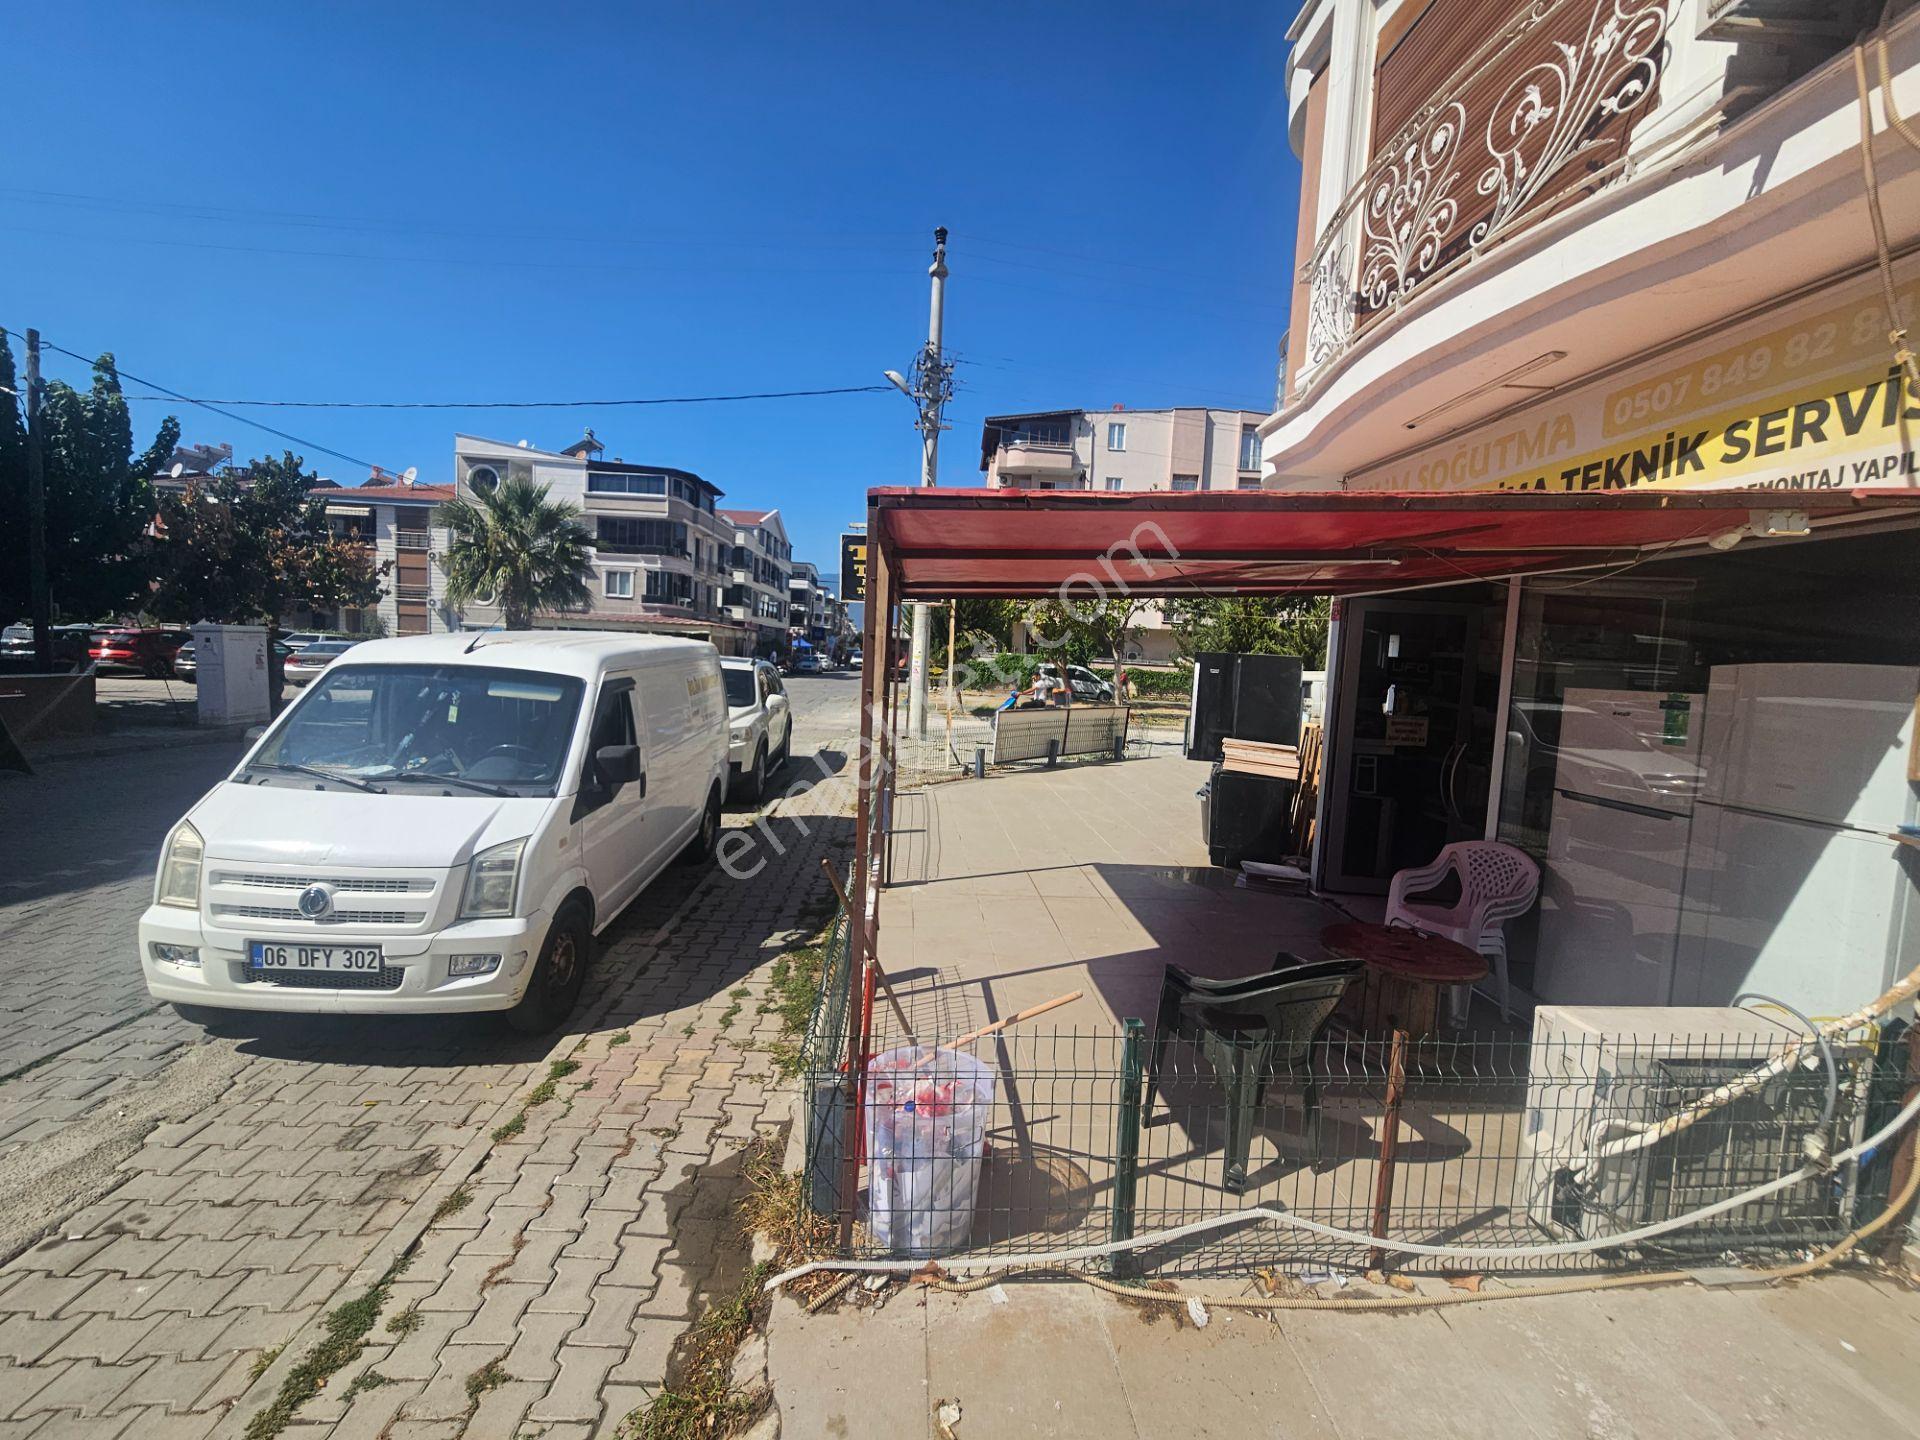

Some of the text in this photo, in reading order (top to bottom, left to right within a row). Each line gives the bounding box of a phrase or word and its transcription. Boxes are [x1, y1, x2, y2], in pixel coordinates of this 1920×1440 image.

[1614, 372, 1693, 425] 0507
[1701, 347, 1772, 397] 849
[1784, 322, 1838, 368] 82
[1417, 412, 1576, 490] SOĞUTMA
[1561, 430, 1709, 490] TEKNİK
[264, 947, 287, 967] 06
[298, 948, 333, 968] DFY
[342, 949, 377, 970] 302
